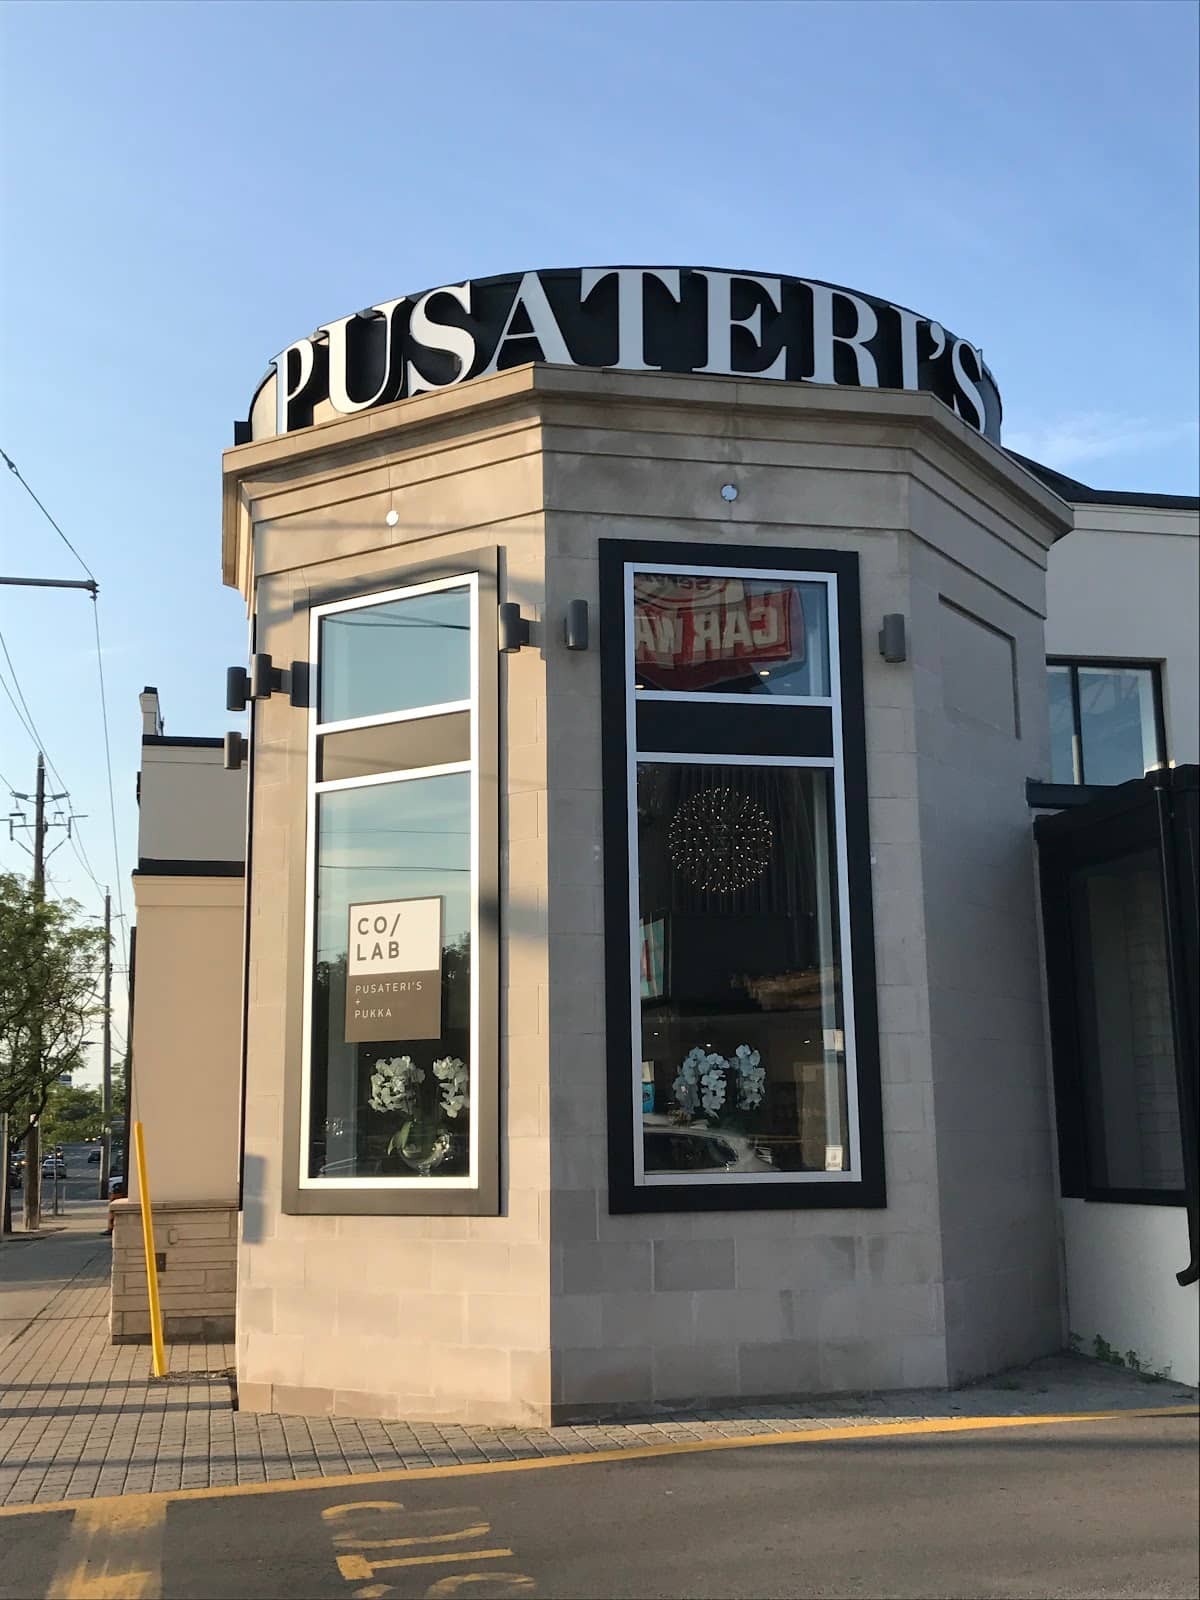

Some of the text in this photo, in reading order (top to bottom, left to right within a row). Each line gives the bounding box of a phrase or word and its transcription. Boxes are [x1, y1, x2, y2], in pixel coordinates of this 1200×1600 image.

[269, 267, 986, 434] PUSATERI'S
[357, 913, 401, 937] CO/
[356, 941, 400, 961] LAB
[354, 981, 423, 994] PUSATERI'S
[354, 1007, 392, 1019] PUKKA
